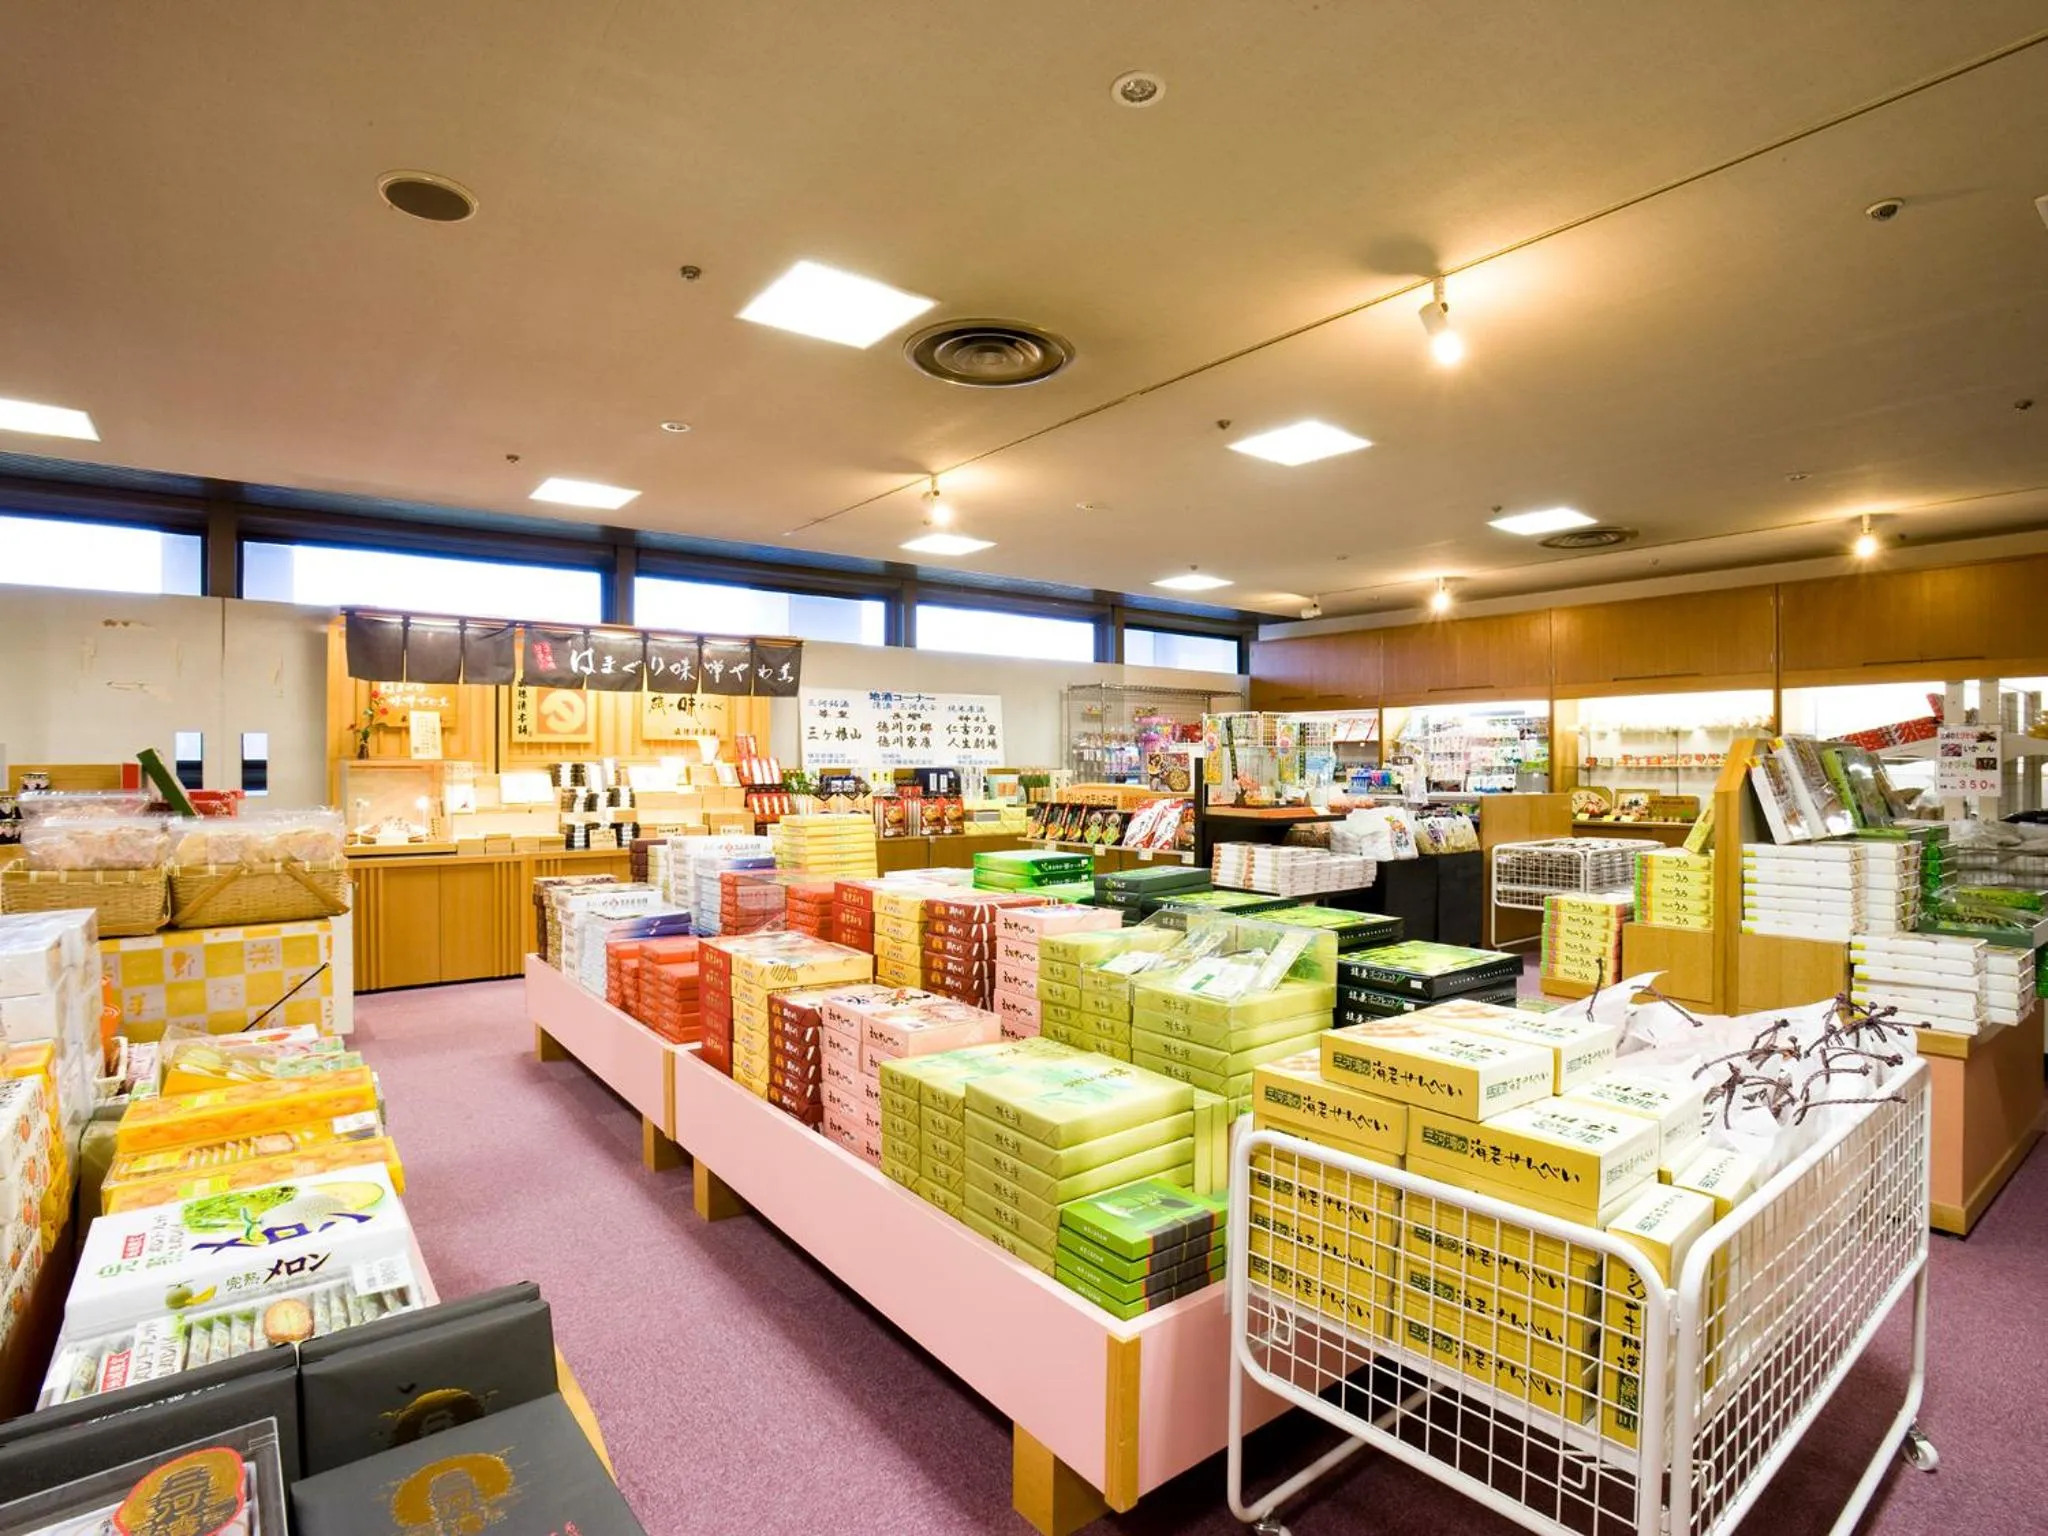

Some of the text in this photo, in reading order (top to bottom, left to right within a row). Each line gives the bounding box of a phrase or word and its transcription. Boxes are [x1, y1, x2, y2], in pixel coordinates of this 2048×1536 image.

[869, 692, 936, 703] 地酒コーナー
[876, 735, 932, 748] 徳川家康
[947, 737, 998, 750] 人生劇場
[1372, 1060, 1463, 1098] 海老せんべい
[1302, 1095, 1389, 1132] 海老せんべい
[1470, 1138, 1581, 1184] 海老せんべい
[263, 1252, 332, 1284] メロン
